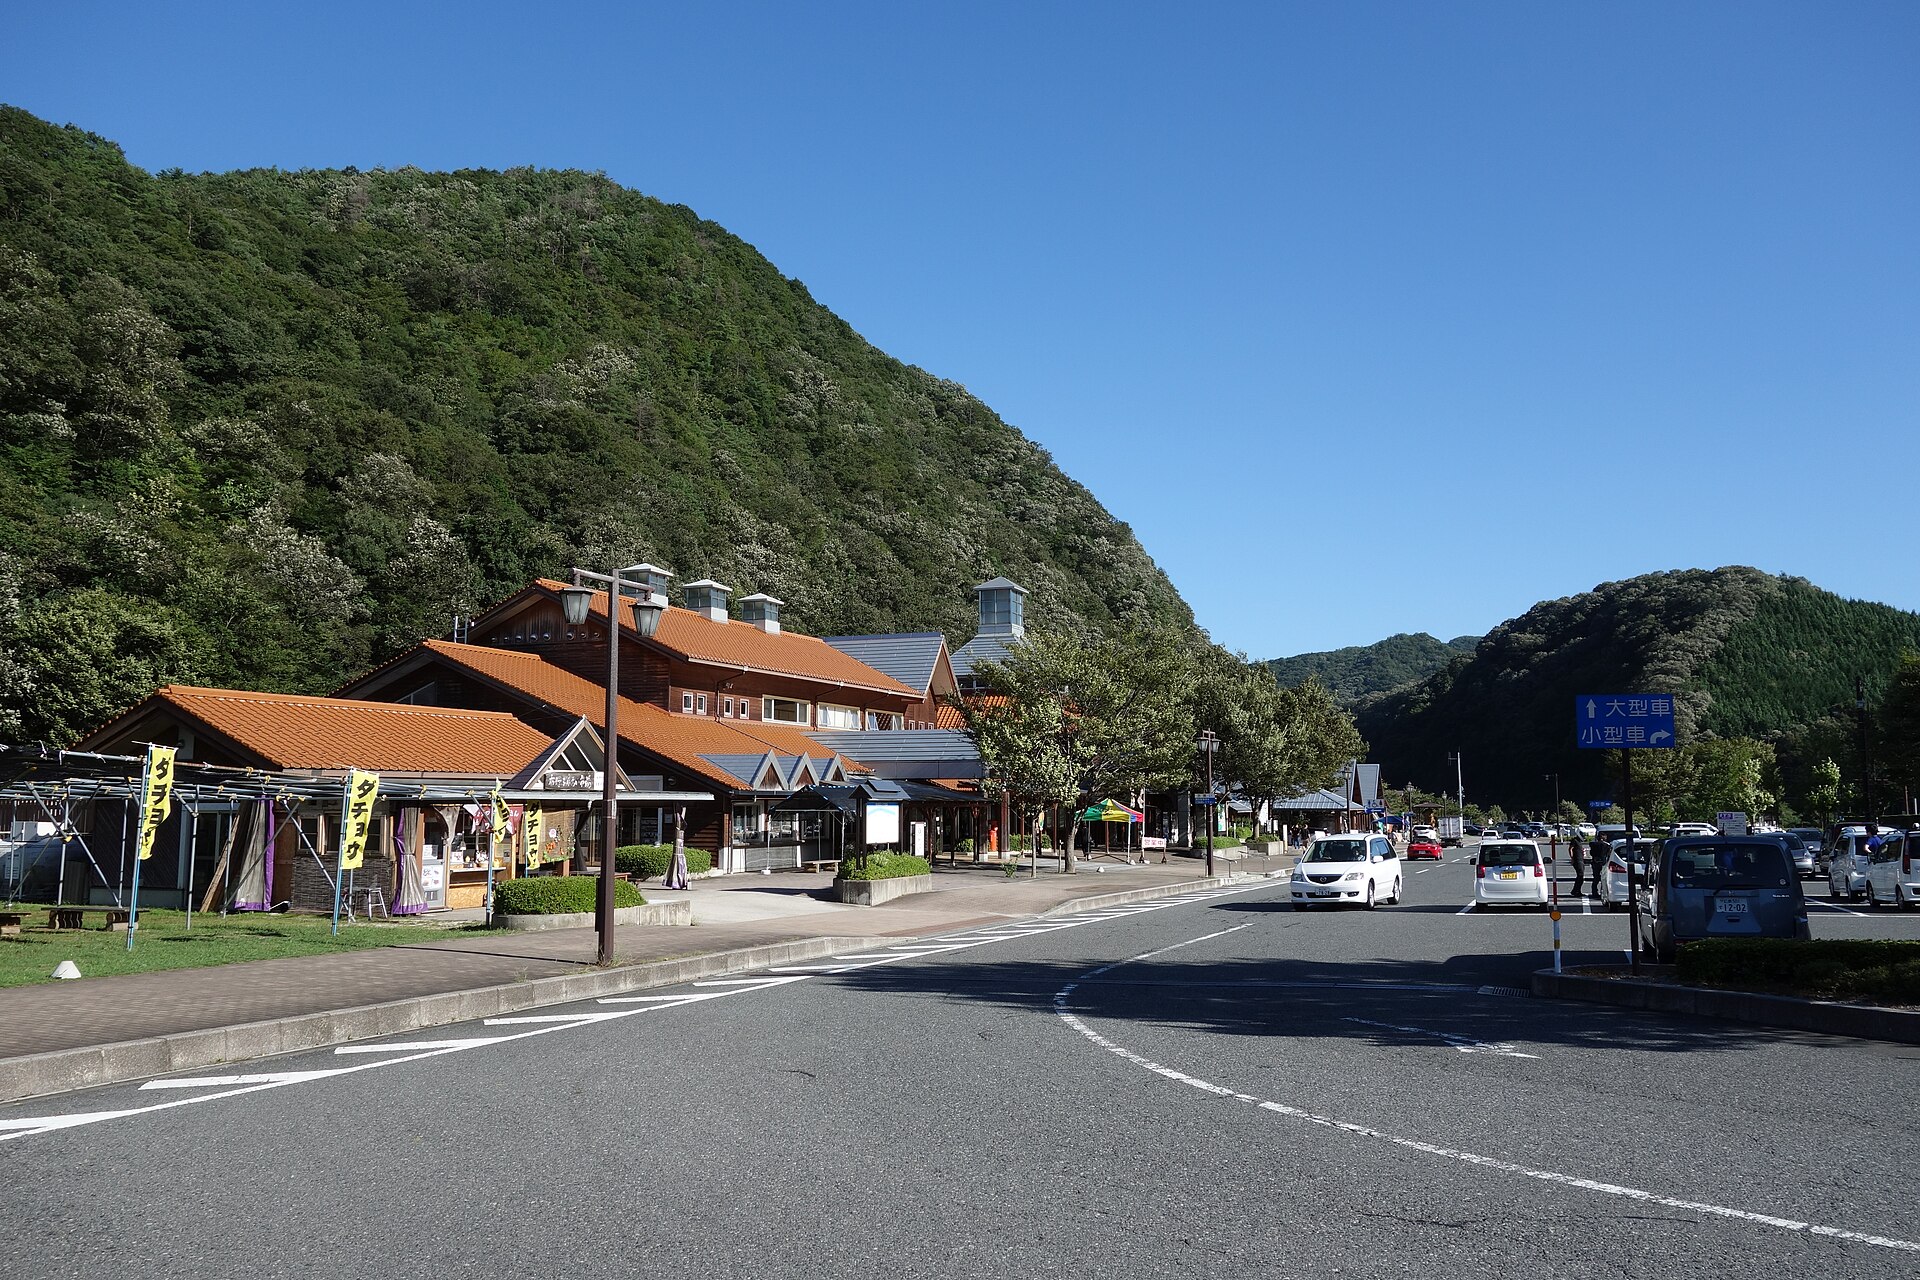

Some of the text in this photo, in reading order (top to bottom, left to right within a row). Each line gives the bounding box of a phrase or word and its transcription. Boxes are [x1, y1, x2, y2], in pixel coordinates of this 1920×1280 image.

[1605, 698, 1671, 717] 大型車
[1581, 725, 1647, 744] 小型車
[346, 779, 376, 860] ダチョウ
